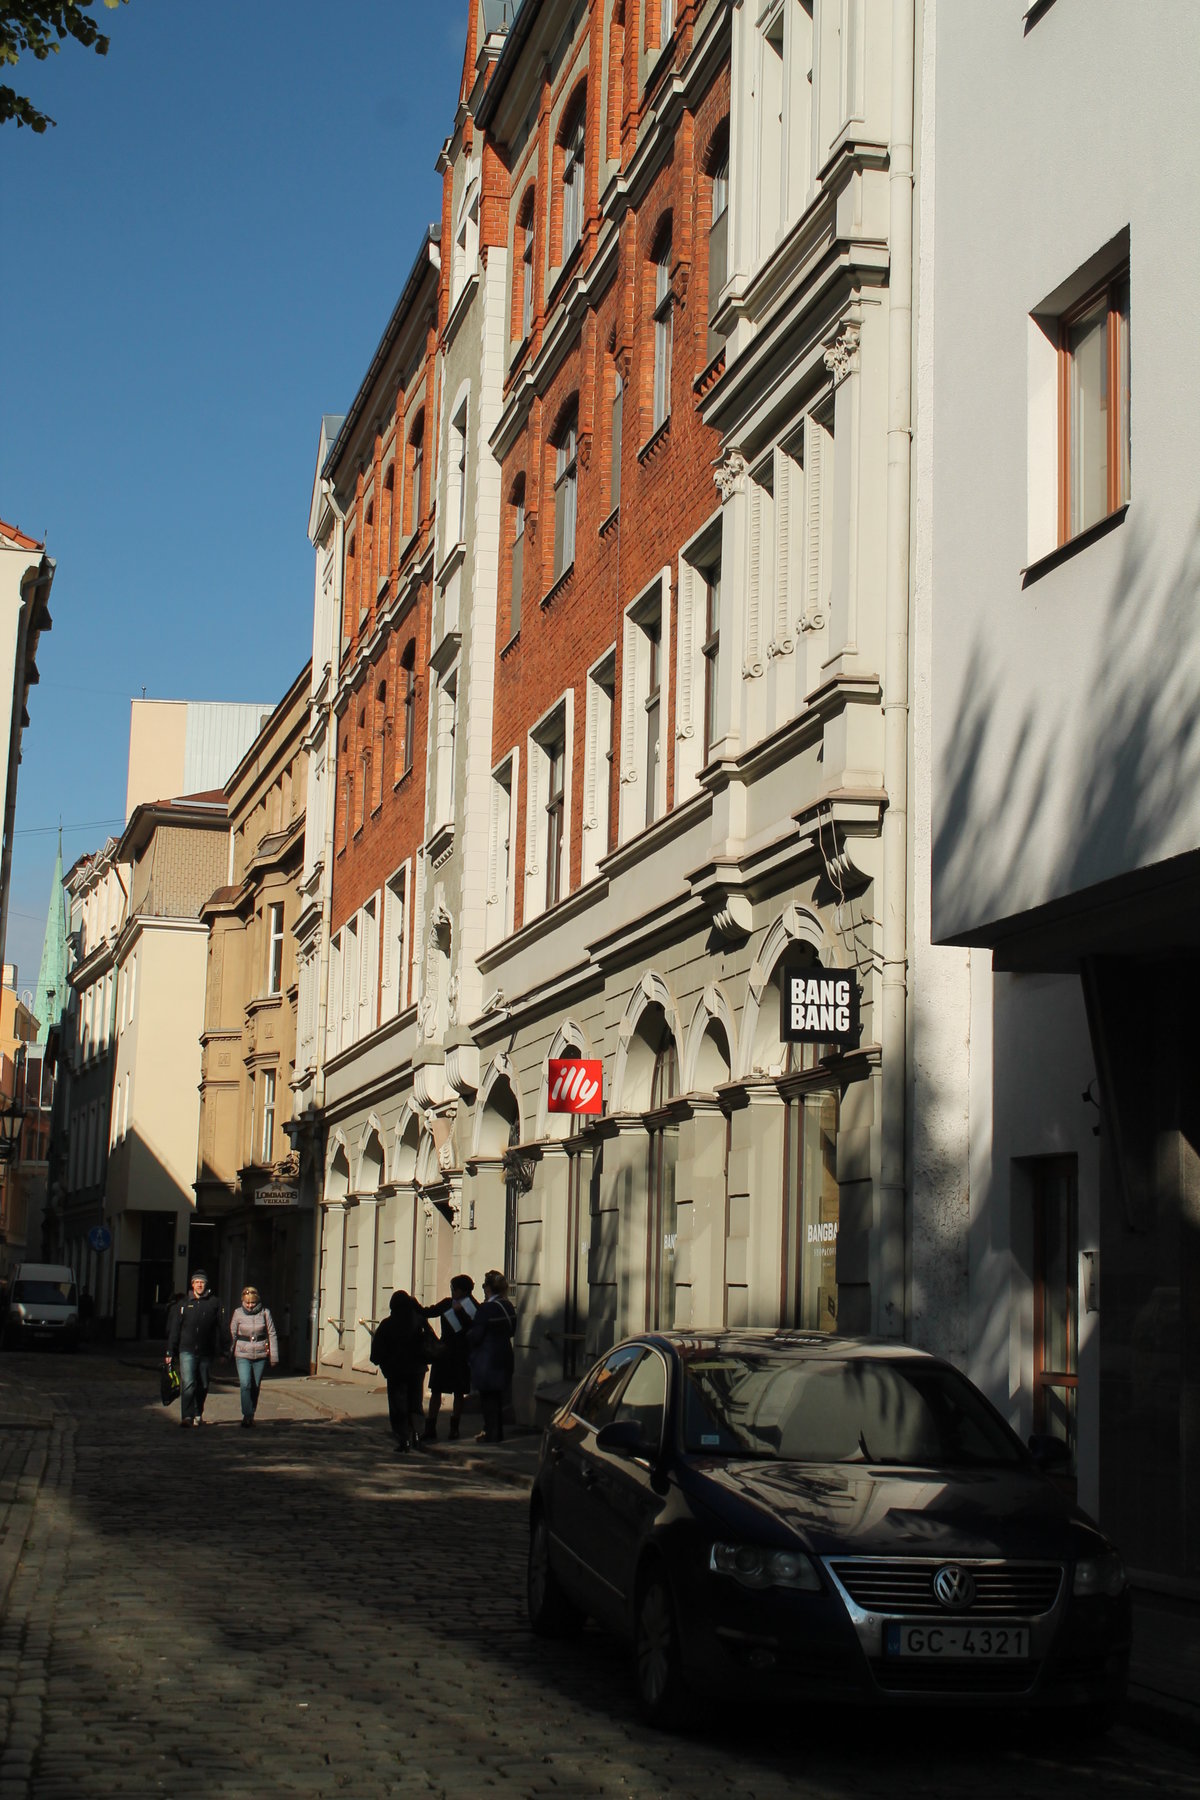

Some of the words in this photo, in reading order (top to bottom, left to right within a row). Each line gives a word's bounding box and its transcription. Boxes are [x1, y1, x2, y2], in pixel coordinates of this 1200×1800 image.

[791, 978, 850, 1005] BANG
[791, 1004, 850, 1032] BANG
[551, 1066, 599, 1108] illy
[256, 1191, 297, 1199] LOMBARDS
[907, 1629, 1022, 1654] GC-4321
